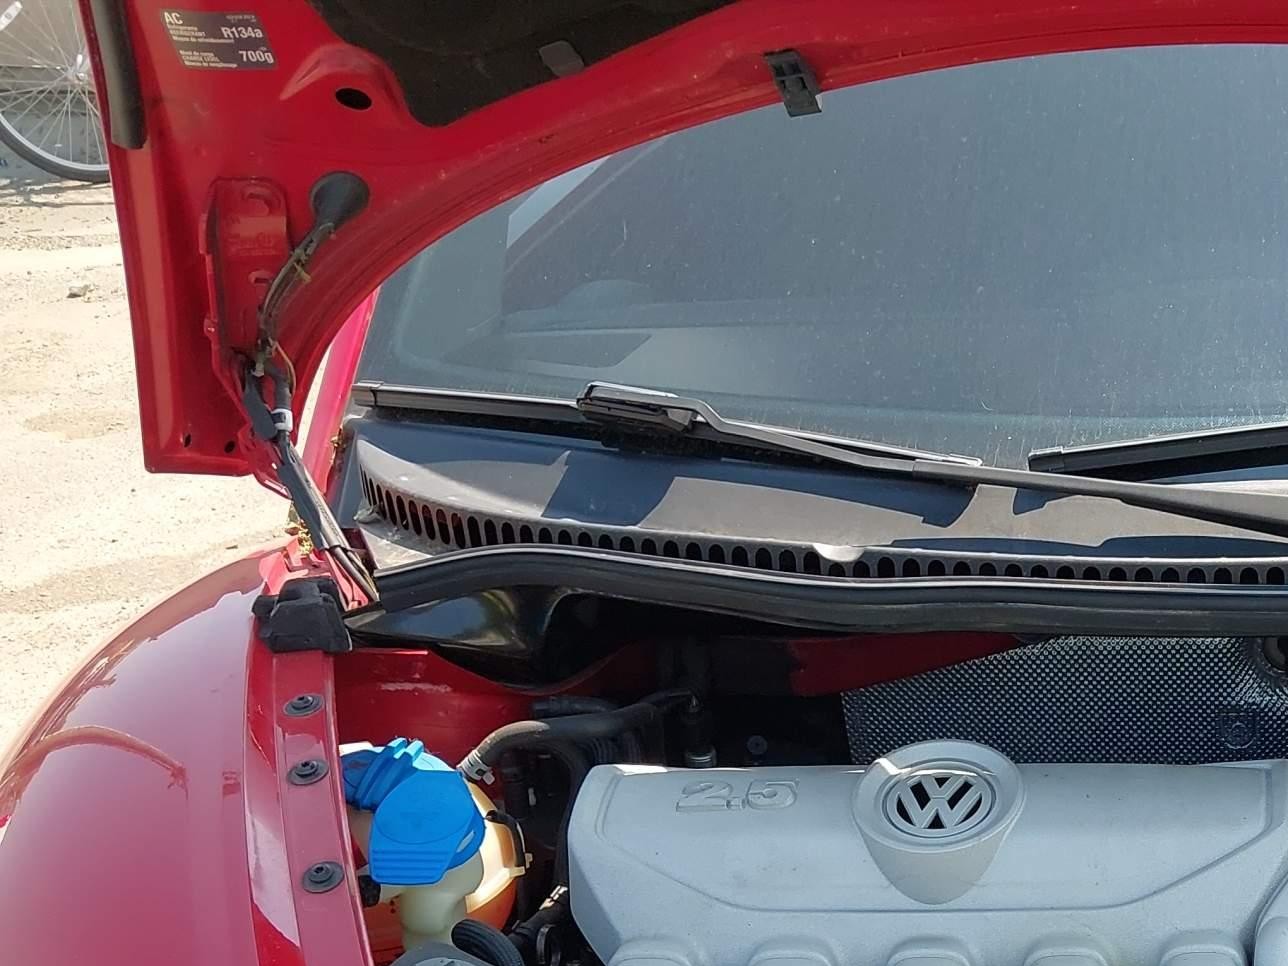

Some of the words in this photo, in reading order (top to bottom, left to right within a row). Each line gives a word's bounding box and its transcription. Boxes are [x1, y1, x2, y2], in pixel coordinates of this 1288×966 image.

[163, 11, 183, 25] AC
[221, 26, 264, 39] R134a
[238, 50, 275, 64] 700g
[675, 778, 799, 813] 2.5
